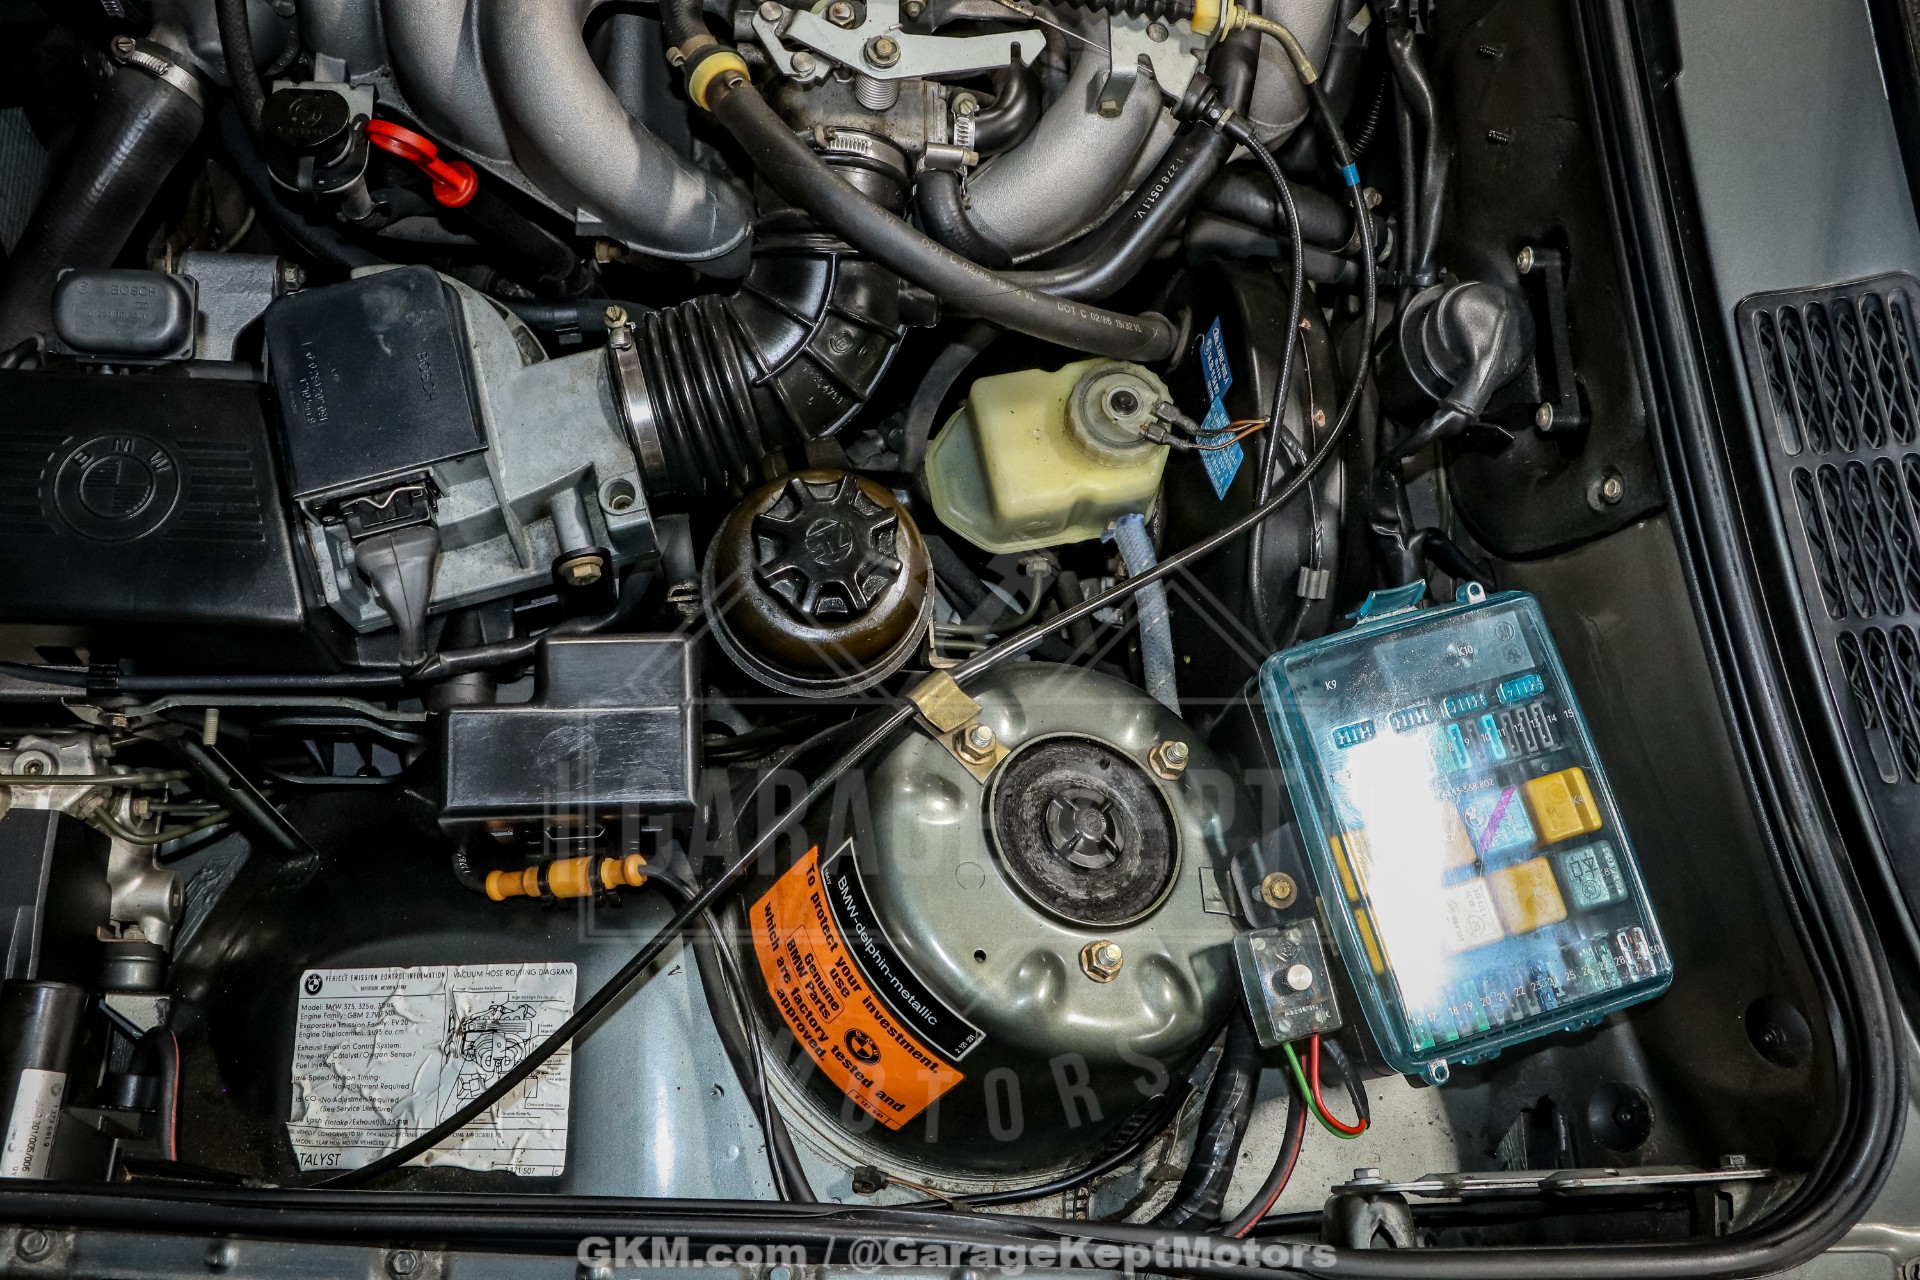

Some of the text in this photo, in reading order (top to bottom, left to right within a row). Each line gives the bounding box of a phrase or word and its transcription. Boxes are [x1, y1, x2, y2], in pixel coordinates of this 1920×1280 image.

[1161, 164, 1179, 184] 278
[921, 238, 944, 257] DOT
[111, 284, 158, 298] BOSCH
[1057, 303, 1076, 315] DOT
[416, 351, 437, 402] BOSCH
[71, 438, 172, 473] BMW
[1456, 645, 1474, 656] K10
[1325, 680, 1337, 690] K9
[1464, 738, 1470, 747] 9
[1481, 732, 1490, 742] 10
[1513, 723, 1524, 733] 12
[1530, 718, 1540, 728] 13
[1547, 713, 1557, 724] 14
[1563, 708, 1574, 719] 15
[1479, 778, 1494, 789] 802
[1571, 795, 1584, 805] K4
[837, 875, 938, 1026] BMW-delphin-metallic
[505, 969, 537, 977] ROUTING
[539, 968, 573, 976] DIAGRAM
[806, 863, 941, 1074] To protect your investment,
[407, 972, 445, 980] INFORMATION
[786, 938, 831, 1020] BMW Parts
[804, 952, 840, 1012] Genuine
[829, 968, 851, 998] use
[1413, 1017, 1423, 1026] 16
[1427, 1012, 1436, 1022] 17
[1448, 1006, 1459, 1016] 18
[1463, 1001, 1473, 1012] 19
[1480, 996, 1492, 1007] 20
[1496, 991, 1508, 1002] 21
[1513, 986, 1526, 997] 22
[1564, 970, 1576, 981] 25
[1614, 955, 1626, 966] 28
[1648, 944, 1661, 955] 30
[764, 901, 906, 1112] which are factory tested and
[323, 1012, 345, 1020] Family:
[299, 1021, 336, 1030] Evaporative
[338, 1021, 365, 1029] Emission
[776, 988, 827, 1061] approved.
[299, 1031, 321, 1039] Engine
[322, 1030, 366, 1038] Displacement:
[376, 1043, 401, 1051] System:
[380, 1083, 409, 1091] Required
[333, 1096, 367, 1104] Adjustmen
[368, 1096, 399, 1104] Required
[306, 1117, 322, 1125] Lash
[299, 1153, 341, 1166] TALYST
